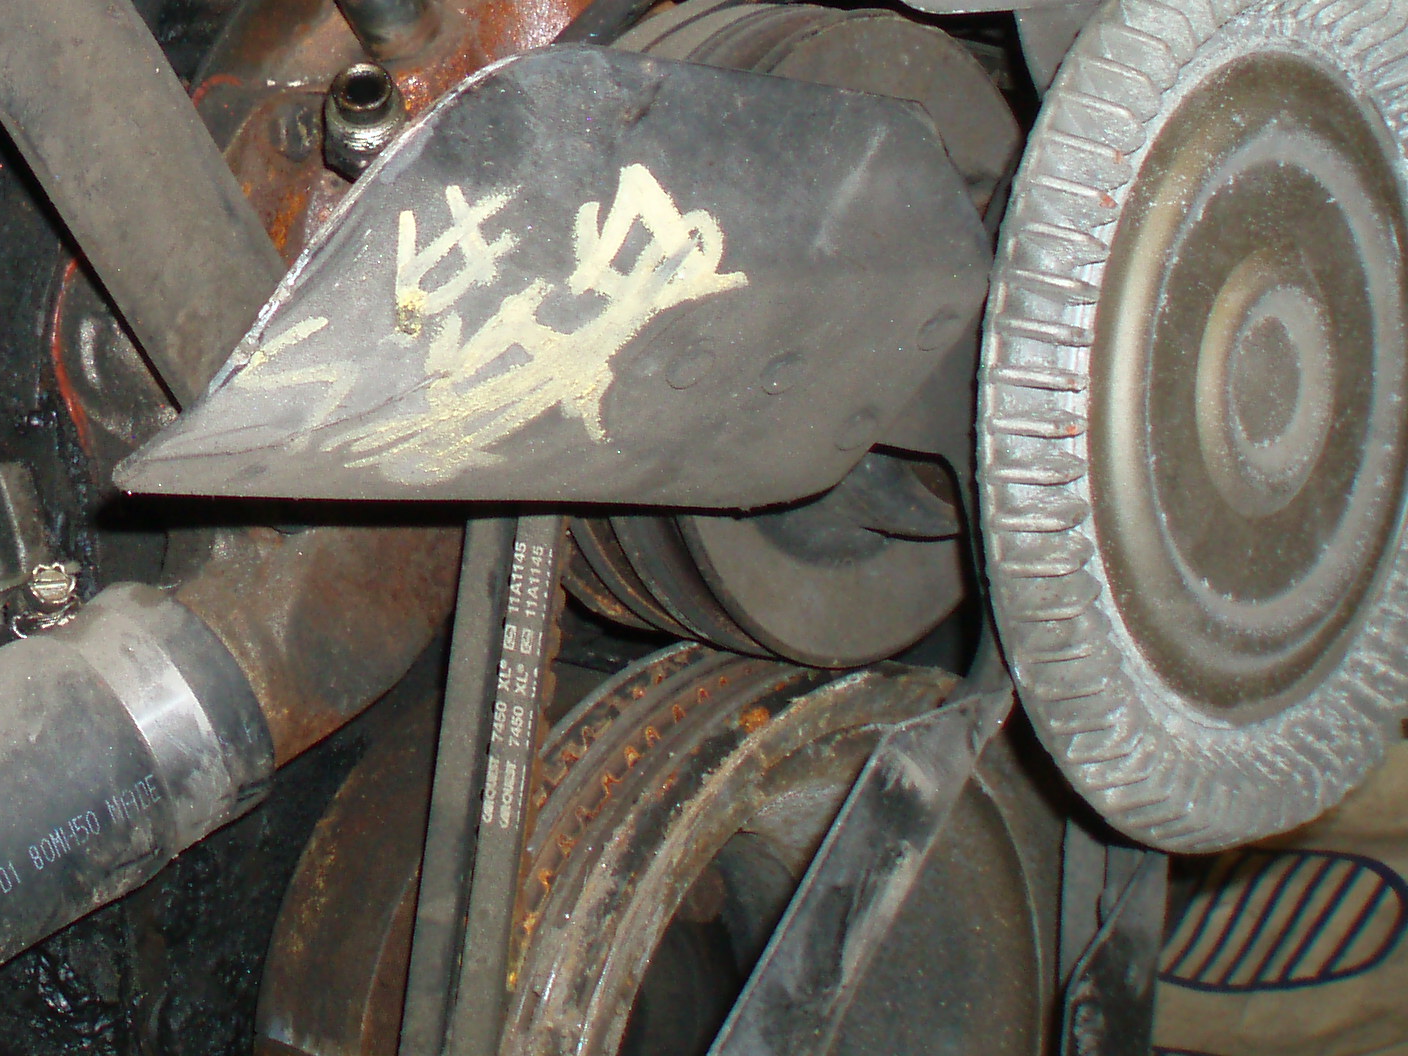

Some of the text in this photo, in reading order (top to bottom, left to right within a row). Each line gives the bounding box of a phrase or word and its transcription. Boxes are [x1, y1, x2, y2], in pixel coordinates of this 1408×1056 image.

[491, 700, 507, 742] 7450
[507, 542, 527, 613] 11A1145
[508, 705, 525, 747] 7450
[524, 545, 544, 618] 11A1145
[104, 773, 162, 825] MADE
